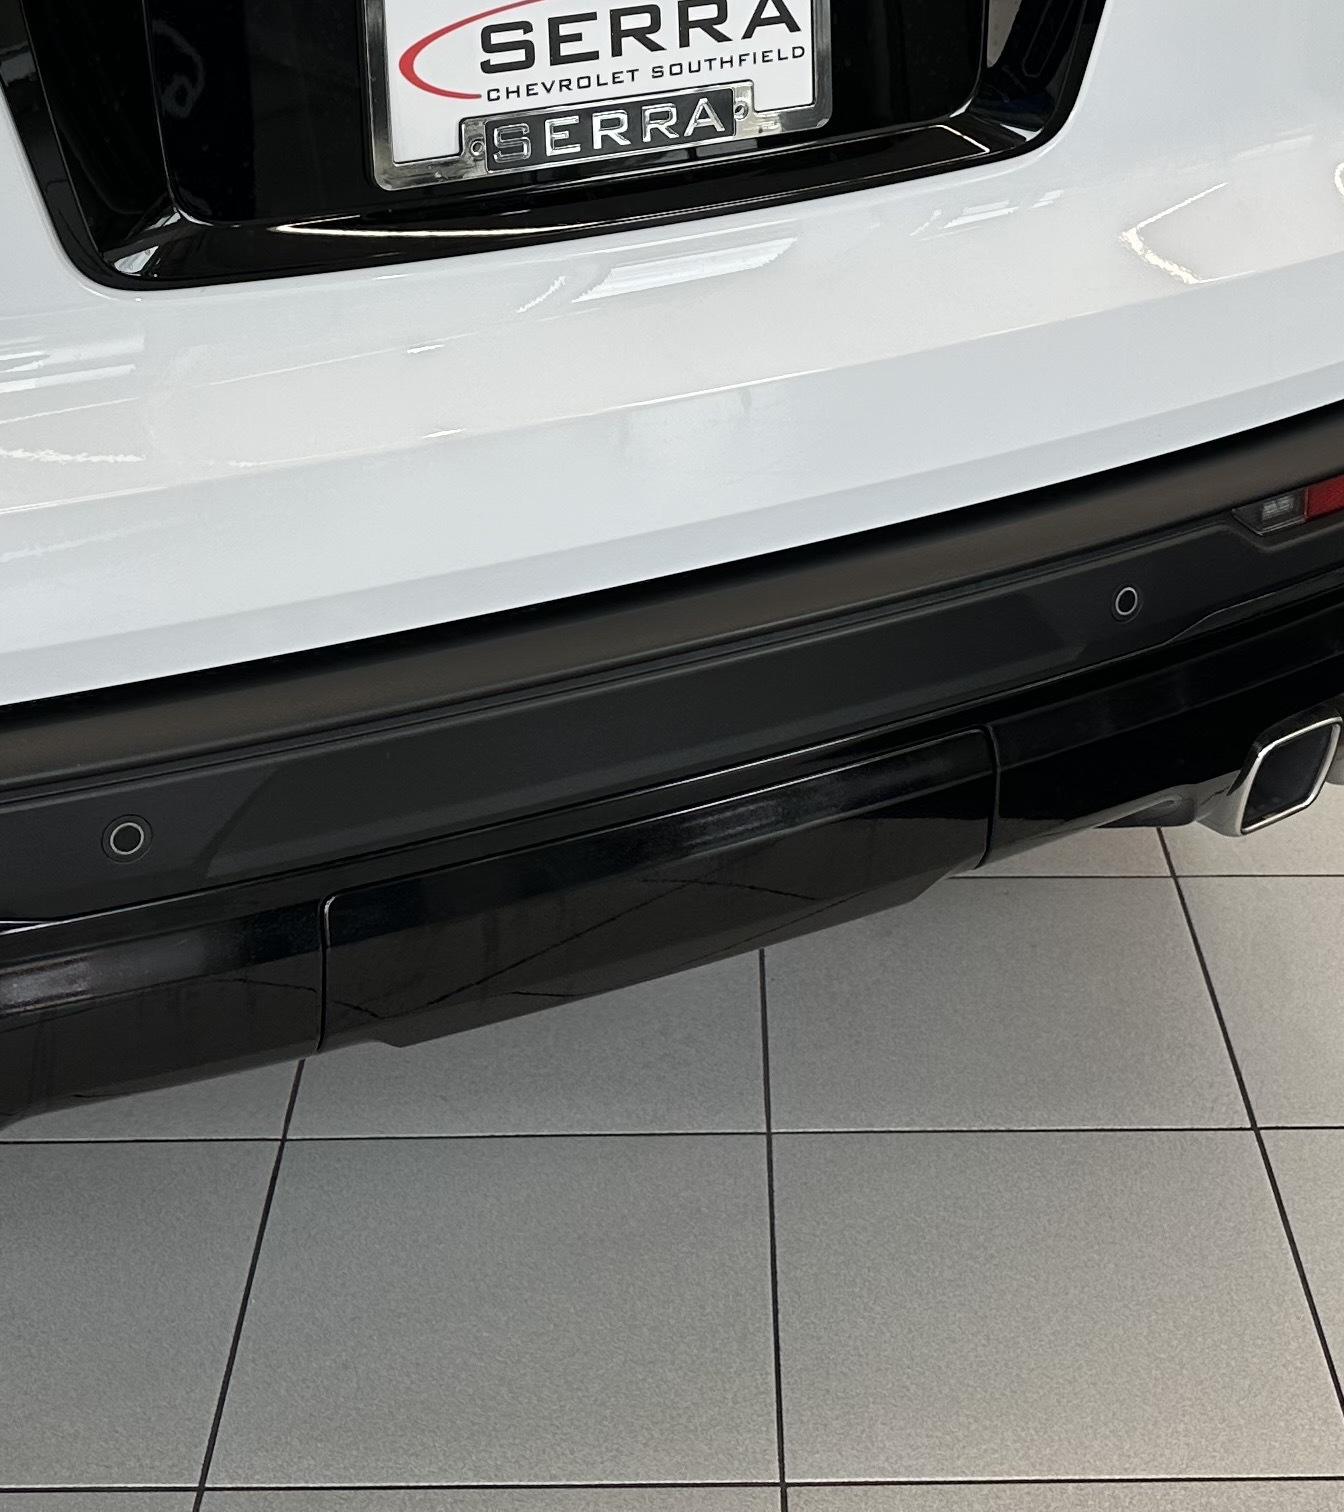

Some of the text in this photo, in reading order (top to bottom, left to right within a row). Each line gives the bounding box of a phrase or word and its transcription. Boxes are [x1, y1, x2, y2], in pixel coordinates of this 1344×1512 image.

[486, 45, 806, 102] CHEVROLET SOUTHFIELD
[492, 96, 726, 164] SERRA
